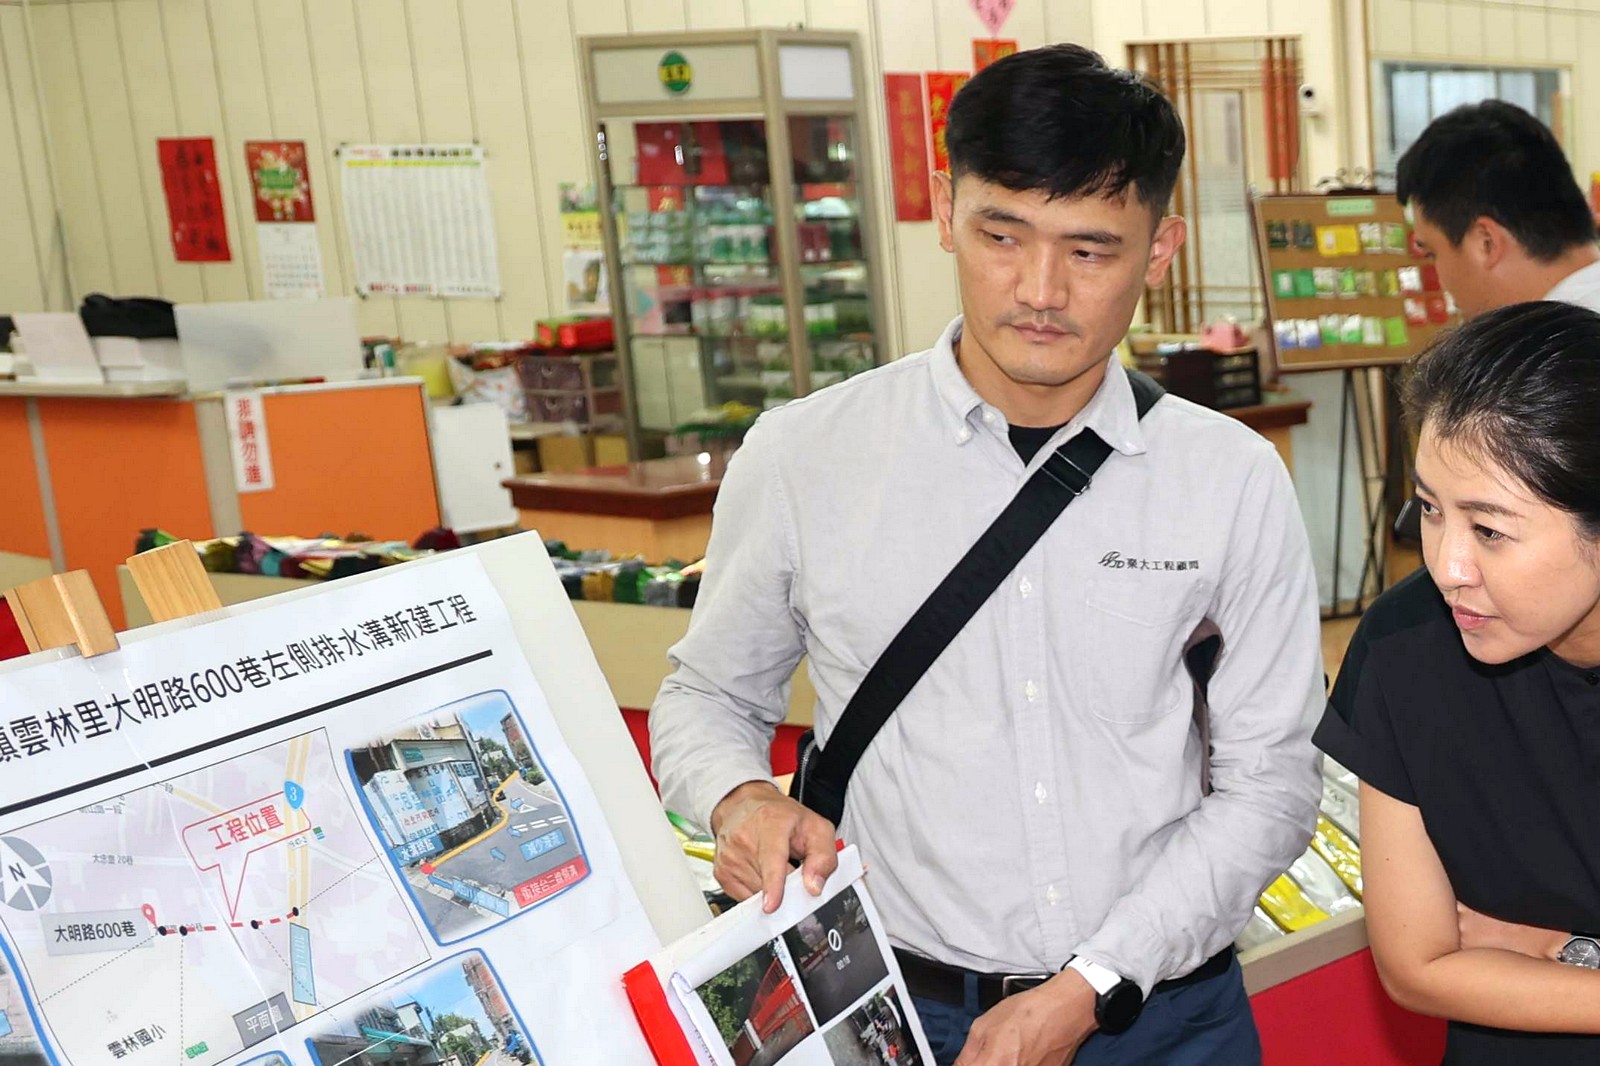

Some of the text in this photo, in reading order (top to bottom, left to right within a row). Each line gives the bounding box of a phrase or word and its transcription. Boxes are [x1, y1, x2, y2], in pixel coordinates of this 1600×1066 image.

[289, 785, 297, 801] 3
[208, 804, 284, 850] 工程位置
[9, 863, 27, 881] N
[54, 920, 137, 943] 大明路600巷
[107, 1023, 166, 1059] 雲林國小
